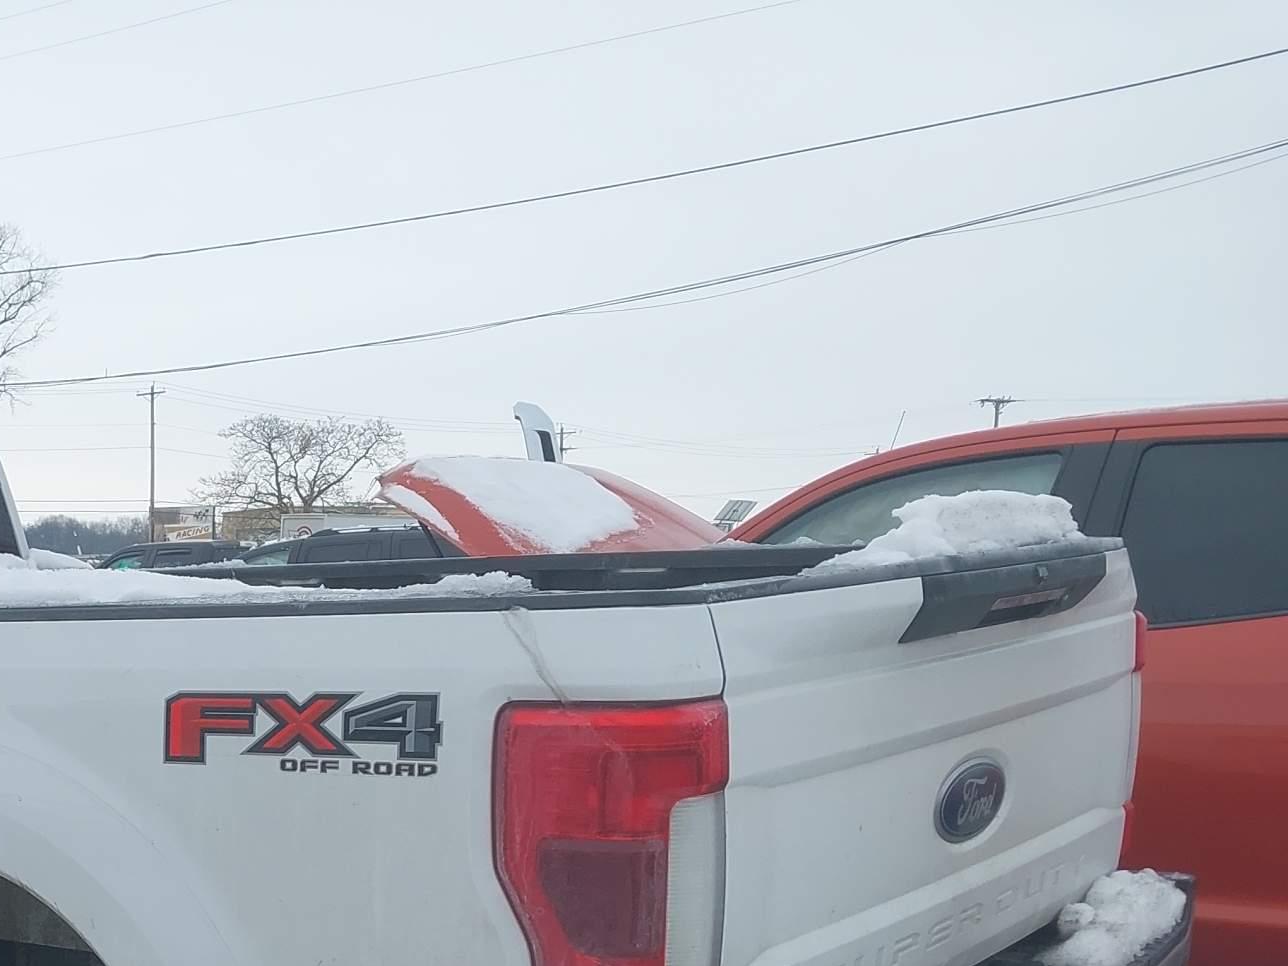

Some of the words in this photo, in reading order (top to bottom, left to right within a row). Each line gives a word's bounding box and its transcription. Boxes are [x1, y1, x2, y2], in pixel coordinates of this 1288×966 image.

[175, 525, 210, 539] RACING
[162, 689, 443, 765] FX4
[279, 758, 340, 774] OFF
[352, 760, 438, 777] ROAD
